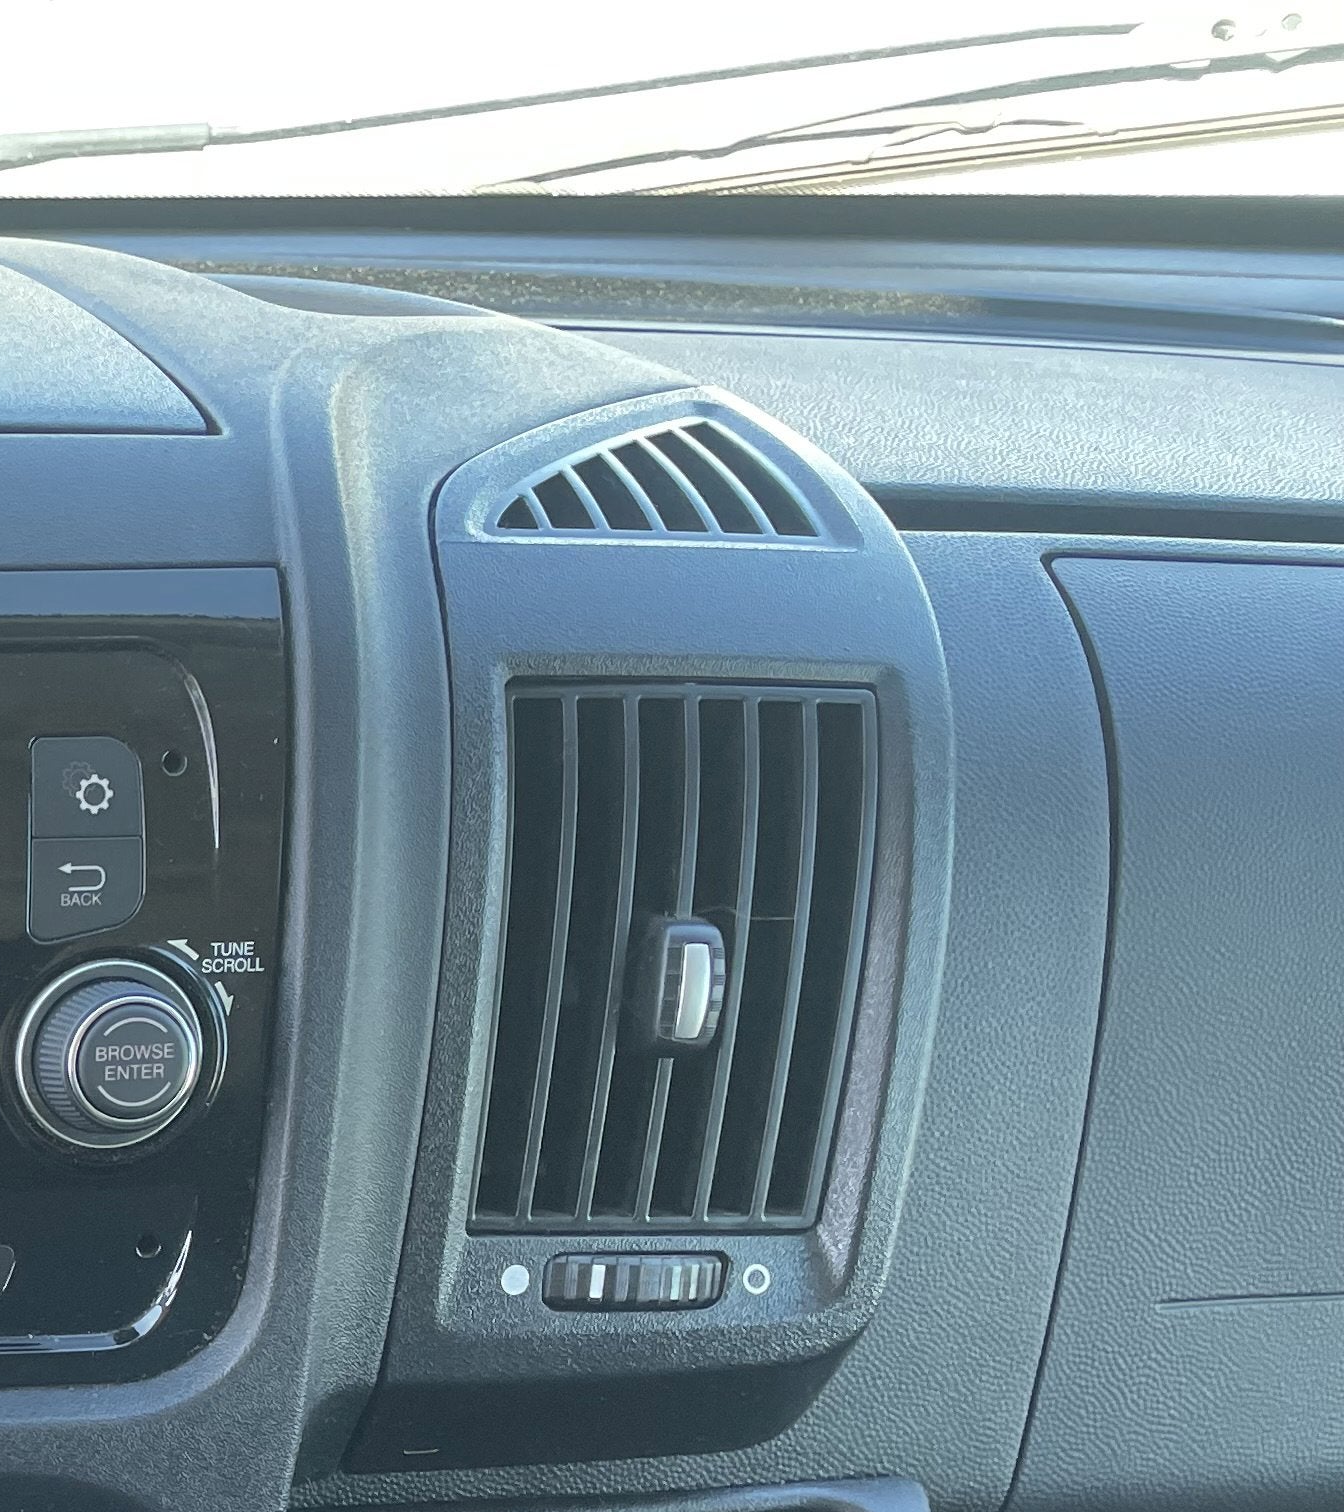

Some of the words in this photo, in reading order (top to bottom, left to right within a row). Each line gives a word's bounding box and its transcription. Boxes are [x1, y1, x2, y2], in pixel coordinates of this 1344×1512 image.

[60, 892, 102, 907] BACK
[210, 941, 255, 957] TUNE
[201, 957, 265, 974] SCROLL
[95, 1042, 174, 1062] BROWSE
[104, 1062, 165, 1081] ENTER
